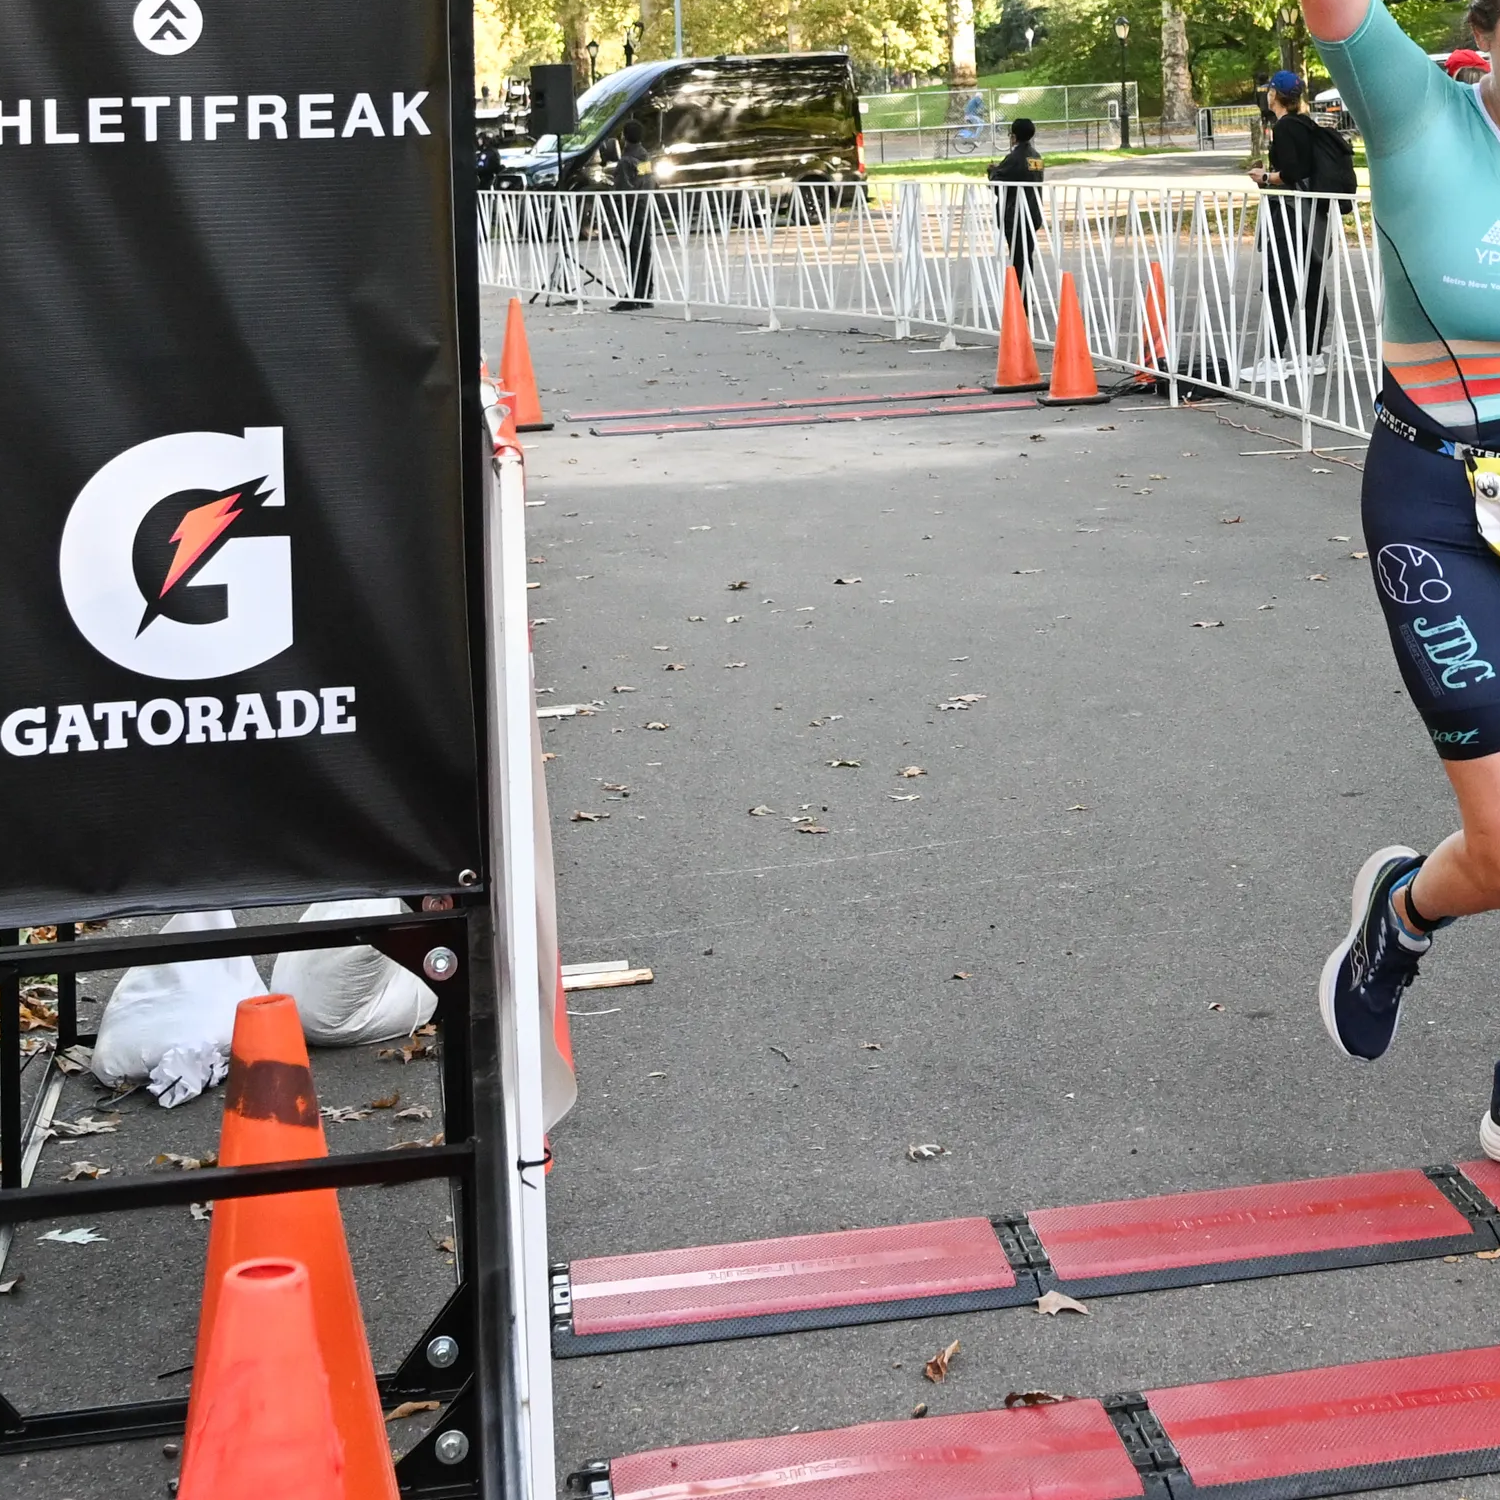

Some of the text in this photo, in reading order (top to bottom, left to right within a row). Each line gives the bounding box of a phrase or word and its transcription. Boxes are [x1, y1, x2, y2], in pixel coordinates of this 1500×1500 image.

[1442, 275, 1467, 287] Metro
[1468, 280, 1488, 289] New
[59, 426, 294, 681] G
[1413, 614, 1496, 689] JDC
[0, 686, 357, 758] GATORADE
